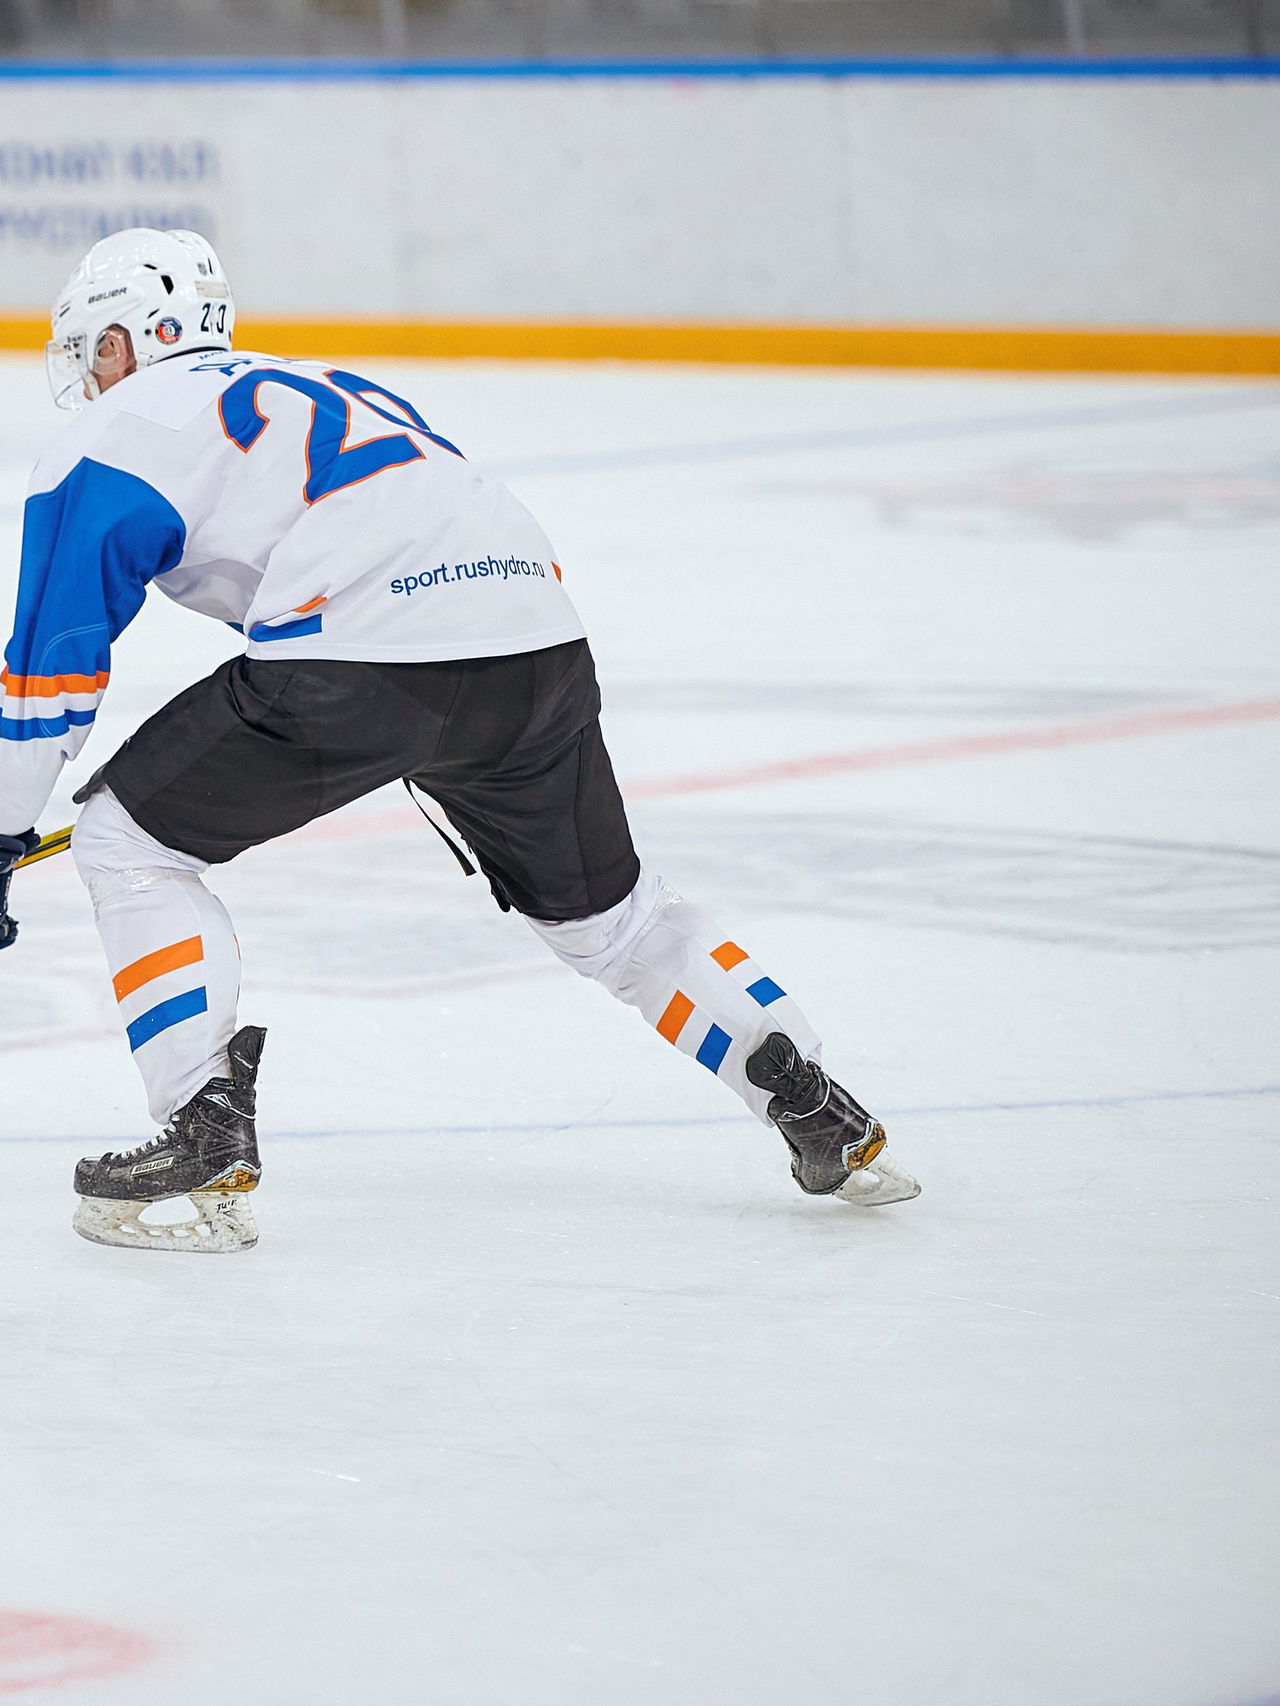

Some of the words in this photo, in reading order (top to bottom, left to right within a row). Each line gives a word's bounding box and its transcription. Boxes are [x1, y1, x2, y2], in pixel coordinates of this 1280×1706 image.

[88, 286, 127, 304] BAUER
[390, 554, 546, 596] sport.rushydro.ru
[134, 1159, 170, 1173] BAUER
